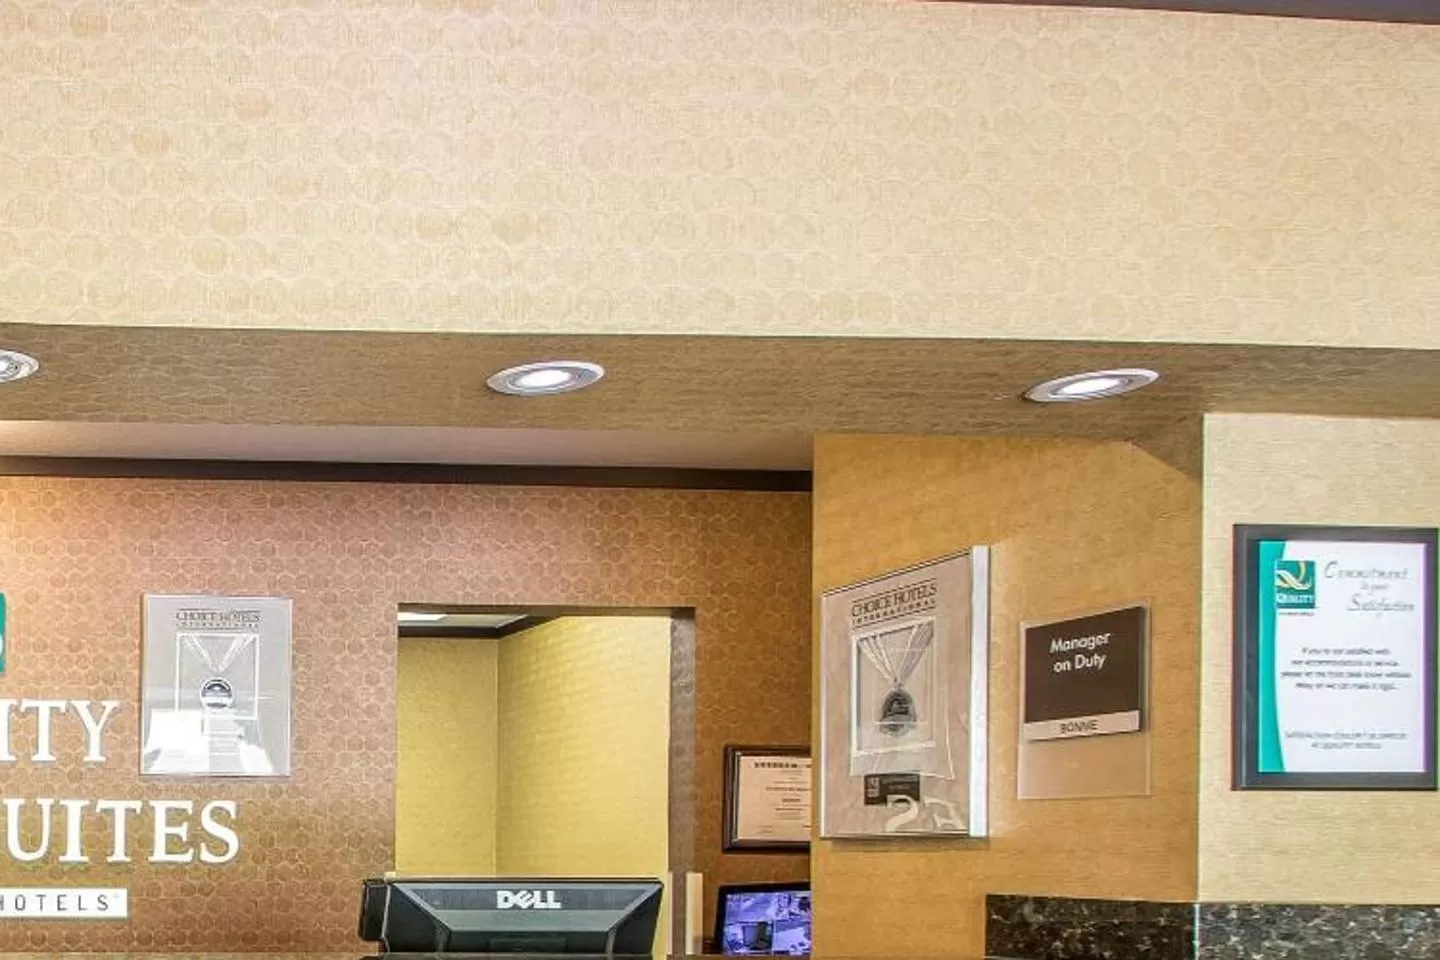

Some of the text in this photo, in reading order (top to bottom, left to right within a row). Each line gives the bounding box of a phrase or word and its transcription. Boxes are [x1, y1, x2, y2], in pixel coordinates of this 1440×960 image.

[1050, 632, 1111, 653] Manager
[1054, 654, 1106, 672] on Duty
[1060, 720, 1098, 734] BONNIE
[496, 890, 562, 909] DELL
